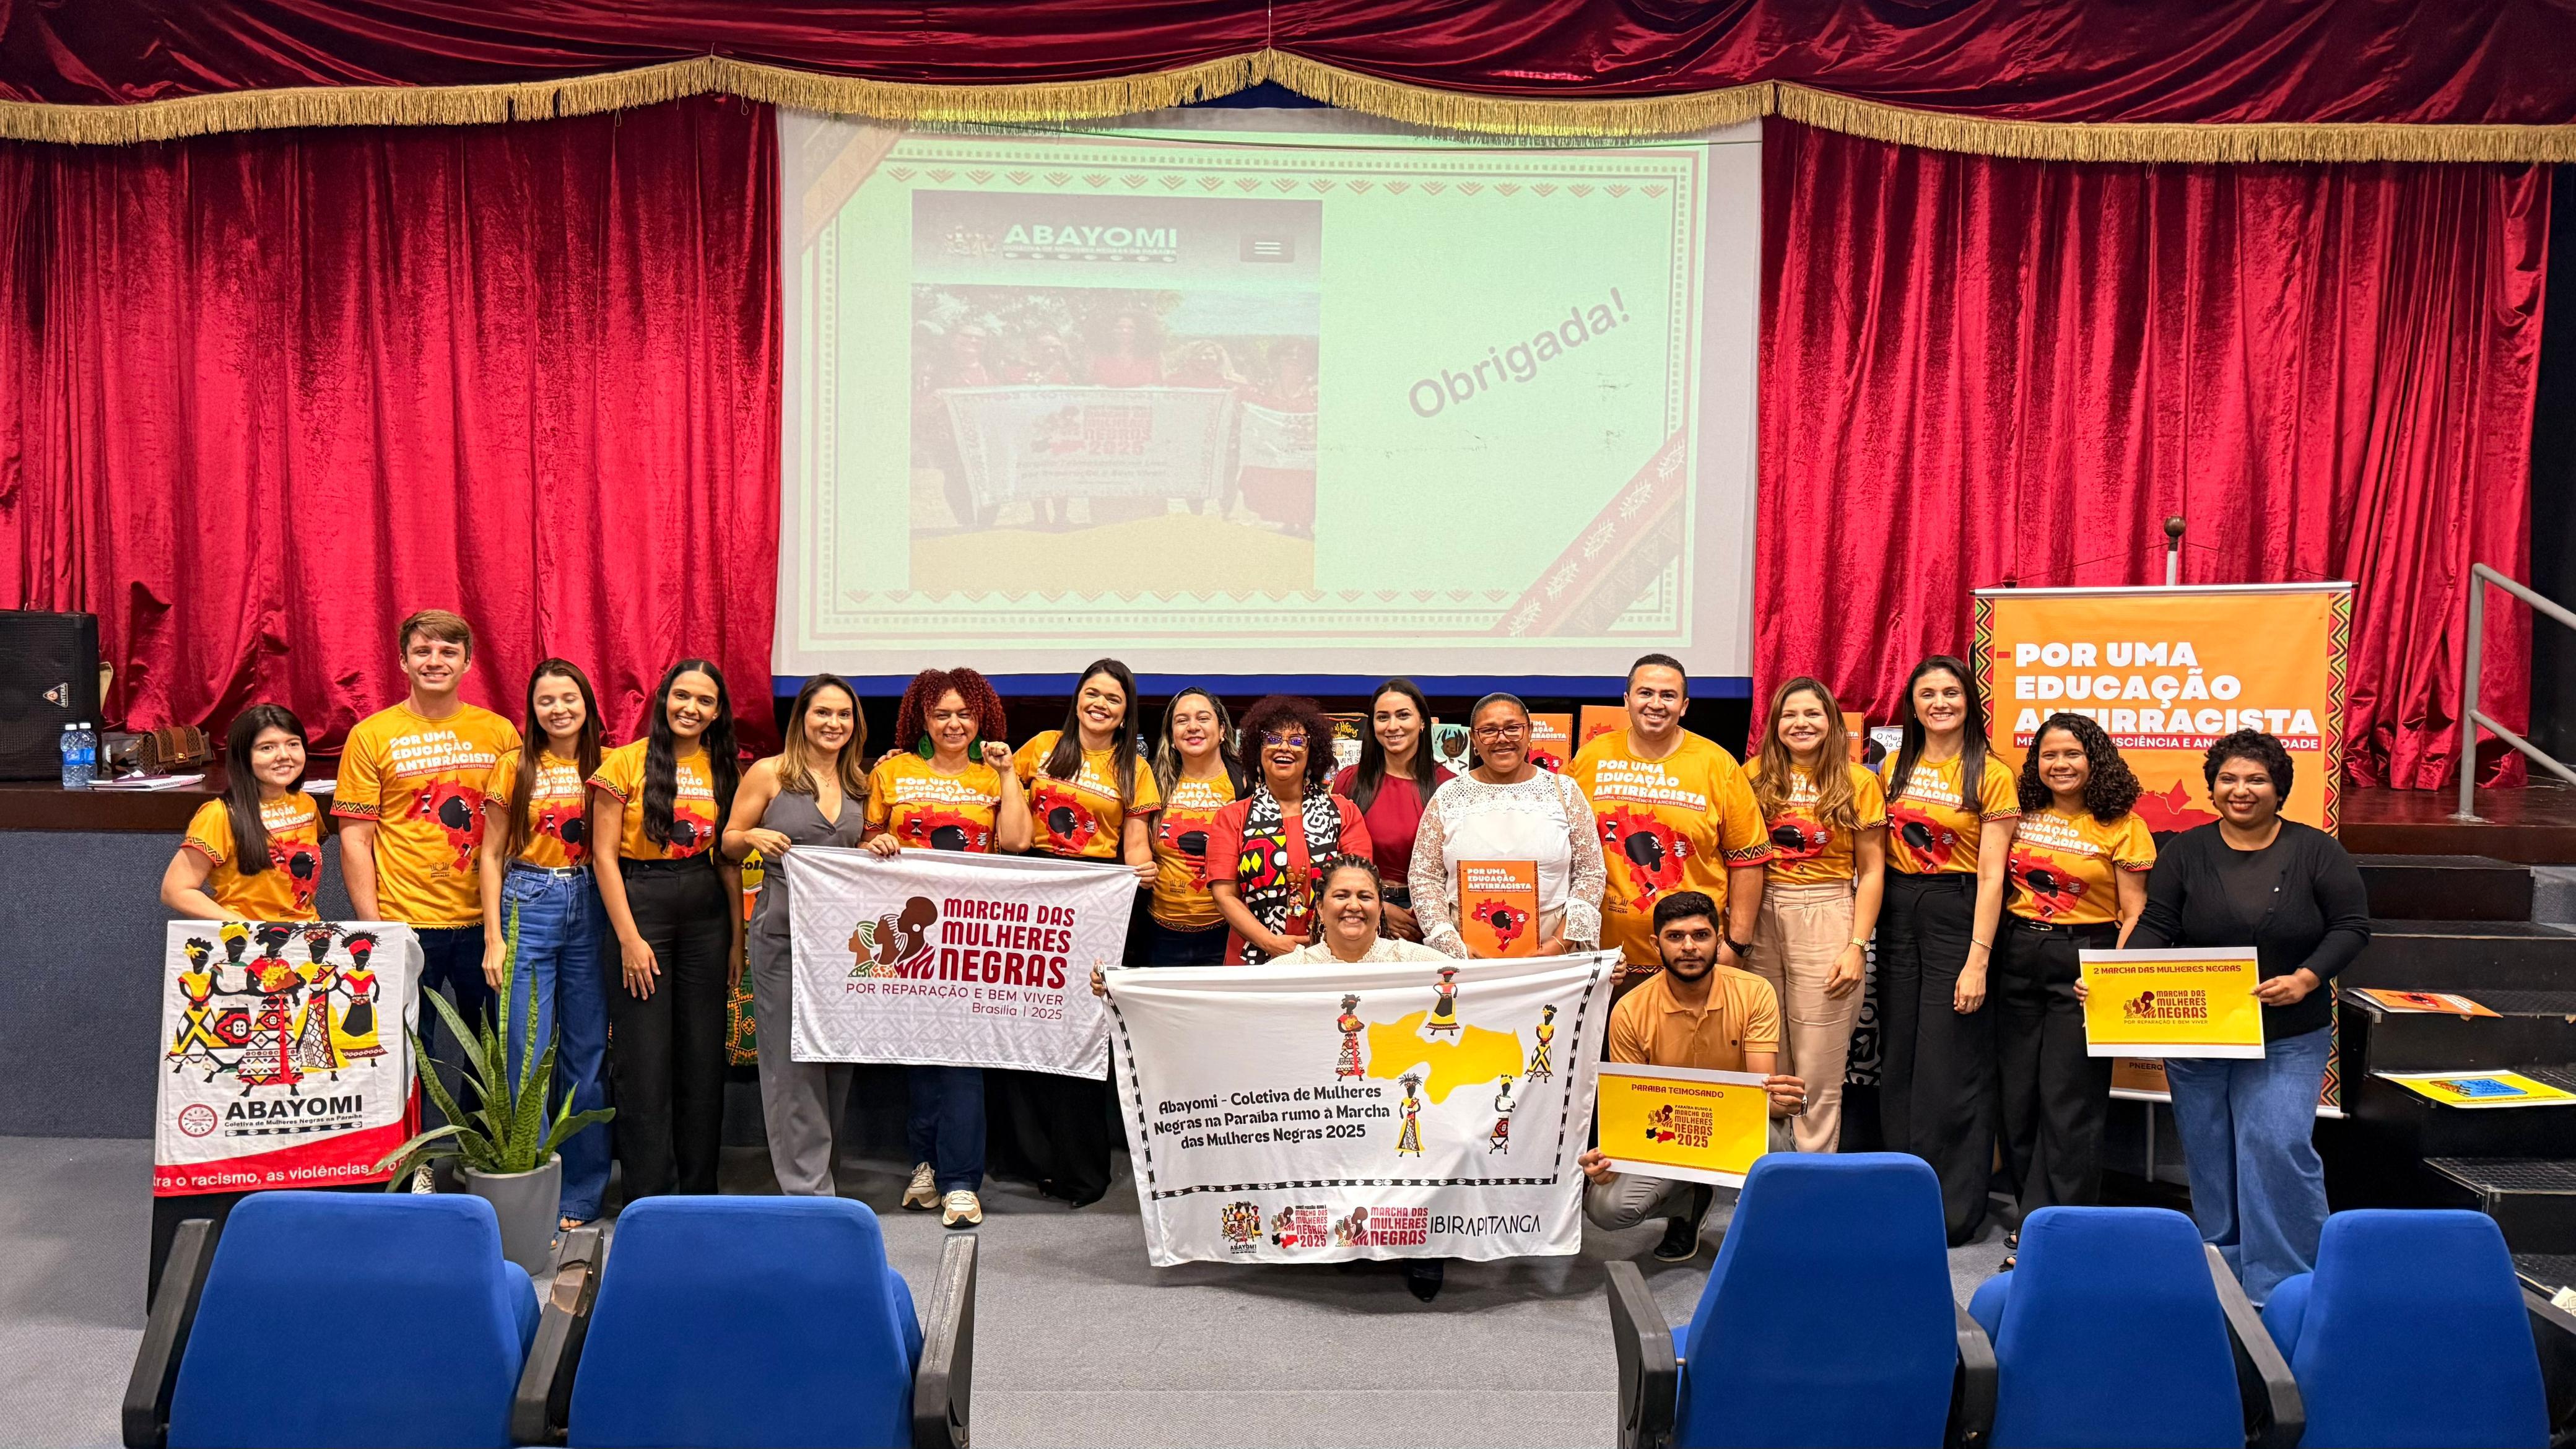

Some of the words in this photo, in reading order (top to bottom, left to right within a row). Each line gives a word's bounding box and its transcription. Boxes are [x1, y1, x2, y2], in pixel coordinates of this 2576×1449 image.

[1004, 224, 1177, 248] ABAYOMI
[1409, 287, 1630, 419] Obrigada!
[2014, 642, 2097, 668] POR
[2106, 642, 2199, 667] UMA
[2014, 668, 2242, 709] EDUCAÇÃO
[389, 734, 422, 749] POR
[423, 730, 457, 743] UMA
[2183, 738, 2190, 747] E
[391, 739, 473, 760] EDUCAÇÃO
[1597, 759, 1629, 770] POR
[1630, 761, 1664, 773] UMA
[895, 777, 926, 785] POR
[929, 777, 962, 787] UMA
[1595, 772, 1679, 788] EDUCAÇÃO
[895, 785, 977, 796] EDUCAÇÃO
[1593, 785, 1707, 806] ANTIRRACISTA
[1657, 799, 1705, 811] ANCESTRALIDADE
[2042, 814, 2069, 826] UMA
[1468, 874, 1516, 884] EDUCAÇÃO
[944, 898, 1029, 923] MARCHA
[1037, 905, 1076, 928] DAS
[942, 921, 1071, 954] MULHERES
[939, 948, 1068, 990] NEGRAS
[2157, 965, 2204, 973] MULHERES
[2206, 964, 2242, 972] NEGRAS
[846, 983, 876, 995] POR
[883, 983, 969, 999] REPARAÇÃO
[975, 988, 982, 998] E
[988, 989, 1017, 1001] BEM
[1024, 992, 1064, 1006] VIVER
[2156, 990, 2188, 998] MARCHA
[2157, 998, 2207, 1006] MULHERES
[972, 1001, 1017, 1017] Brasília
[1032, 1006, 1063, 1020] 2025
[2157, 1007, 2208, 1019] NEGRAS
[1159, 1094, 1219, 1115] Abayomi
[1230, 1090, 1290, 1107] Coletiva
[1294, 1087, 1310, 1101] de
[1313, 1086, 1382, 1100] Mulheres
[1668, 1087, 1724, 1099] TEIMOSANDO
[225, 1095, 363, 1121] ABAYOMI
[1154, 1119, 1202, 1136] Negras
[1205, 1116, 1222, 1127] na
[1224, 1110, 1279, 1126] Paraíba
[1282, 1109, 1321, 1122] rumo
[1325, 1107, 1333, 1120] à
[1336, 1103, 1390, 1119] Marcha
[1675, 1116, 1713, 1126] MULHERES
[1181, 1134, 1204, 1149] das
[1207, 1130, 1270, 1146] Mulheres
[1273, 1127, 1323, 1144] Negras
[1326, 1124, 1366, 1139] 2025
[1674, 1123, 1713, 1136] NEGRAS
[1677, 1133, 1708, 1148] 2025
[176, 1177, 187, 1186] o
[191, 1172, 261, 1186] racismo,
[266, 1171, 285, 1182] as
[1370, 1207, 1408, 1217] MARCHA
[1411, 1207, 1429, 1217] DAS
[1296, 1216, 1328, 1224] MULHERES
[1370, 1217, 1428, 1230] MULHERES
[1430, 1214, 1541, 1237] IBIRAPITANGA
[1297, 1224, 1328, 1235] NEGRAS
[1300, 1235, 1326, 1248] 2025
[1370, 1230, 1427, 1247] NEGRAS
